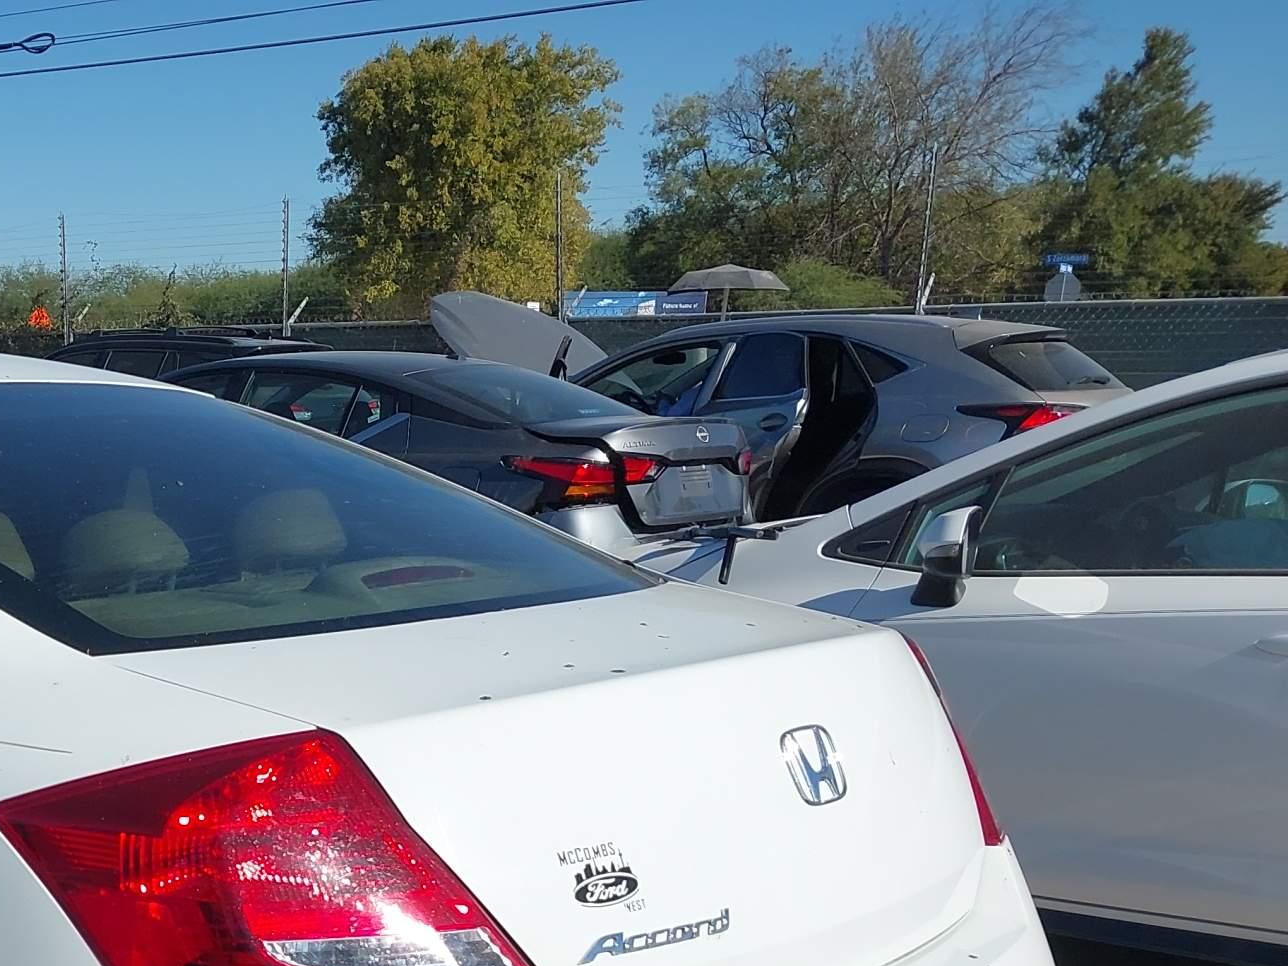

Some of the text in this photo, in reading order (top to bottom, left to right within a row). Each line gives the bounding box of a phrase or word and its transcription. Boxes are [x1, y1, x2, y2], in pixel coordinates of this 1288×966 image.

[585, 877, 629, 902] Ford
[623, 898, 647, 913] WEST
[576, 907, 730, 966] Accord
